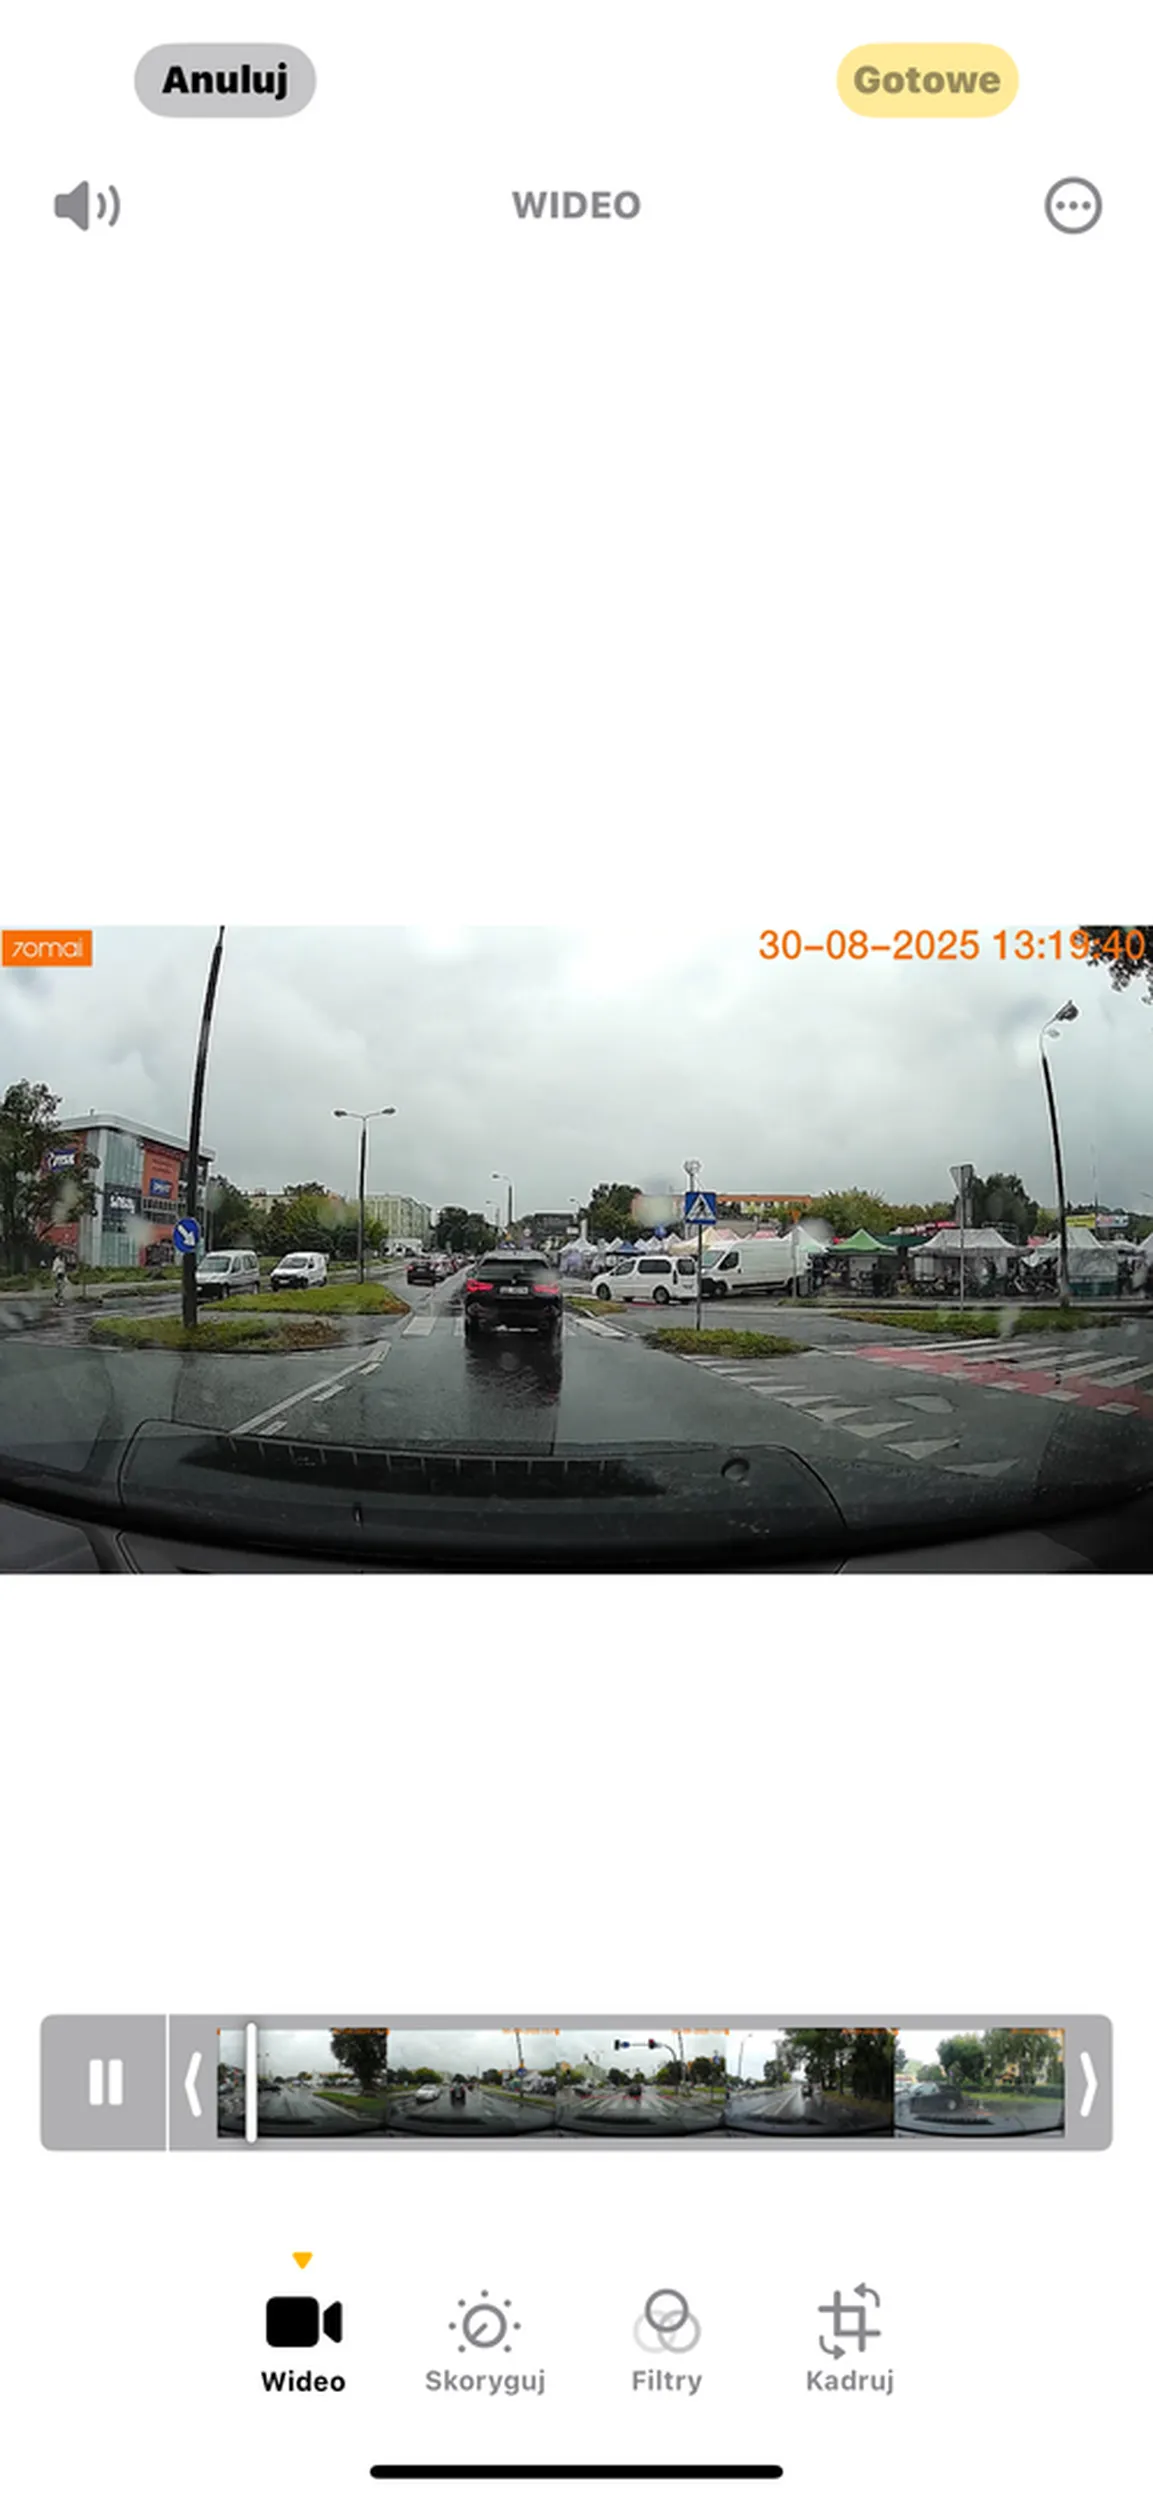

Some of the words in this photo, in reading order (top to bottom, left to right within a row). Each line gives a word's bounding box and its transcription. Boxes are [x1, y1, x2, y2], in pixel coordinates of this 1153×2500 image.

[162, 62, 287, 101] Anuluj
[853, 65, 1001, 95] Gotowe
[511, 190, 641, 220] WIDEO
[260, 2368, 347, 2394] Wideo
[425, 2368, 545, 2398] Skoryguj
[632, 2368, 703, 2398] Filtry
[806, 2368, 894, 2397] Kadruj
